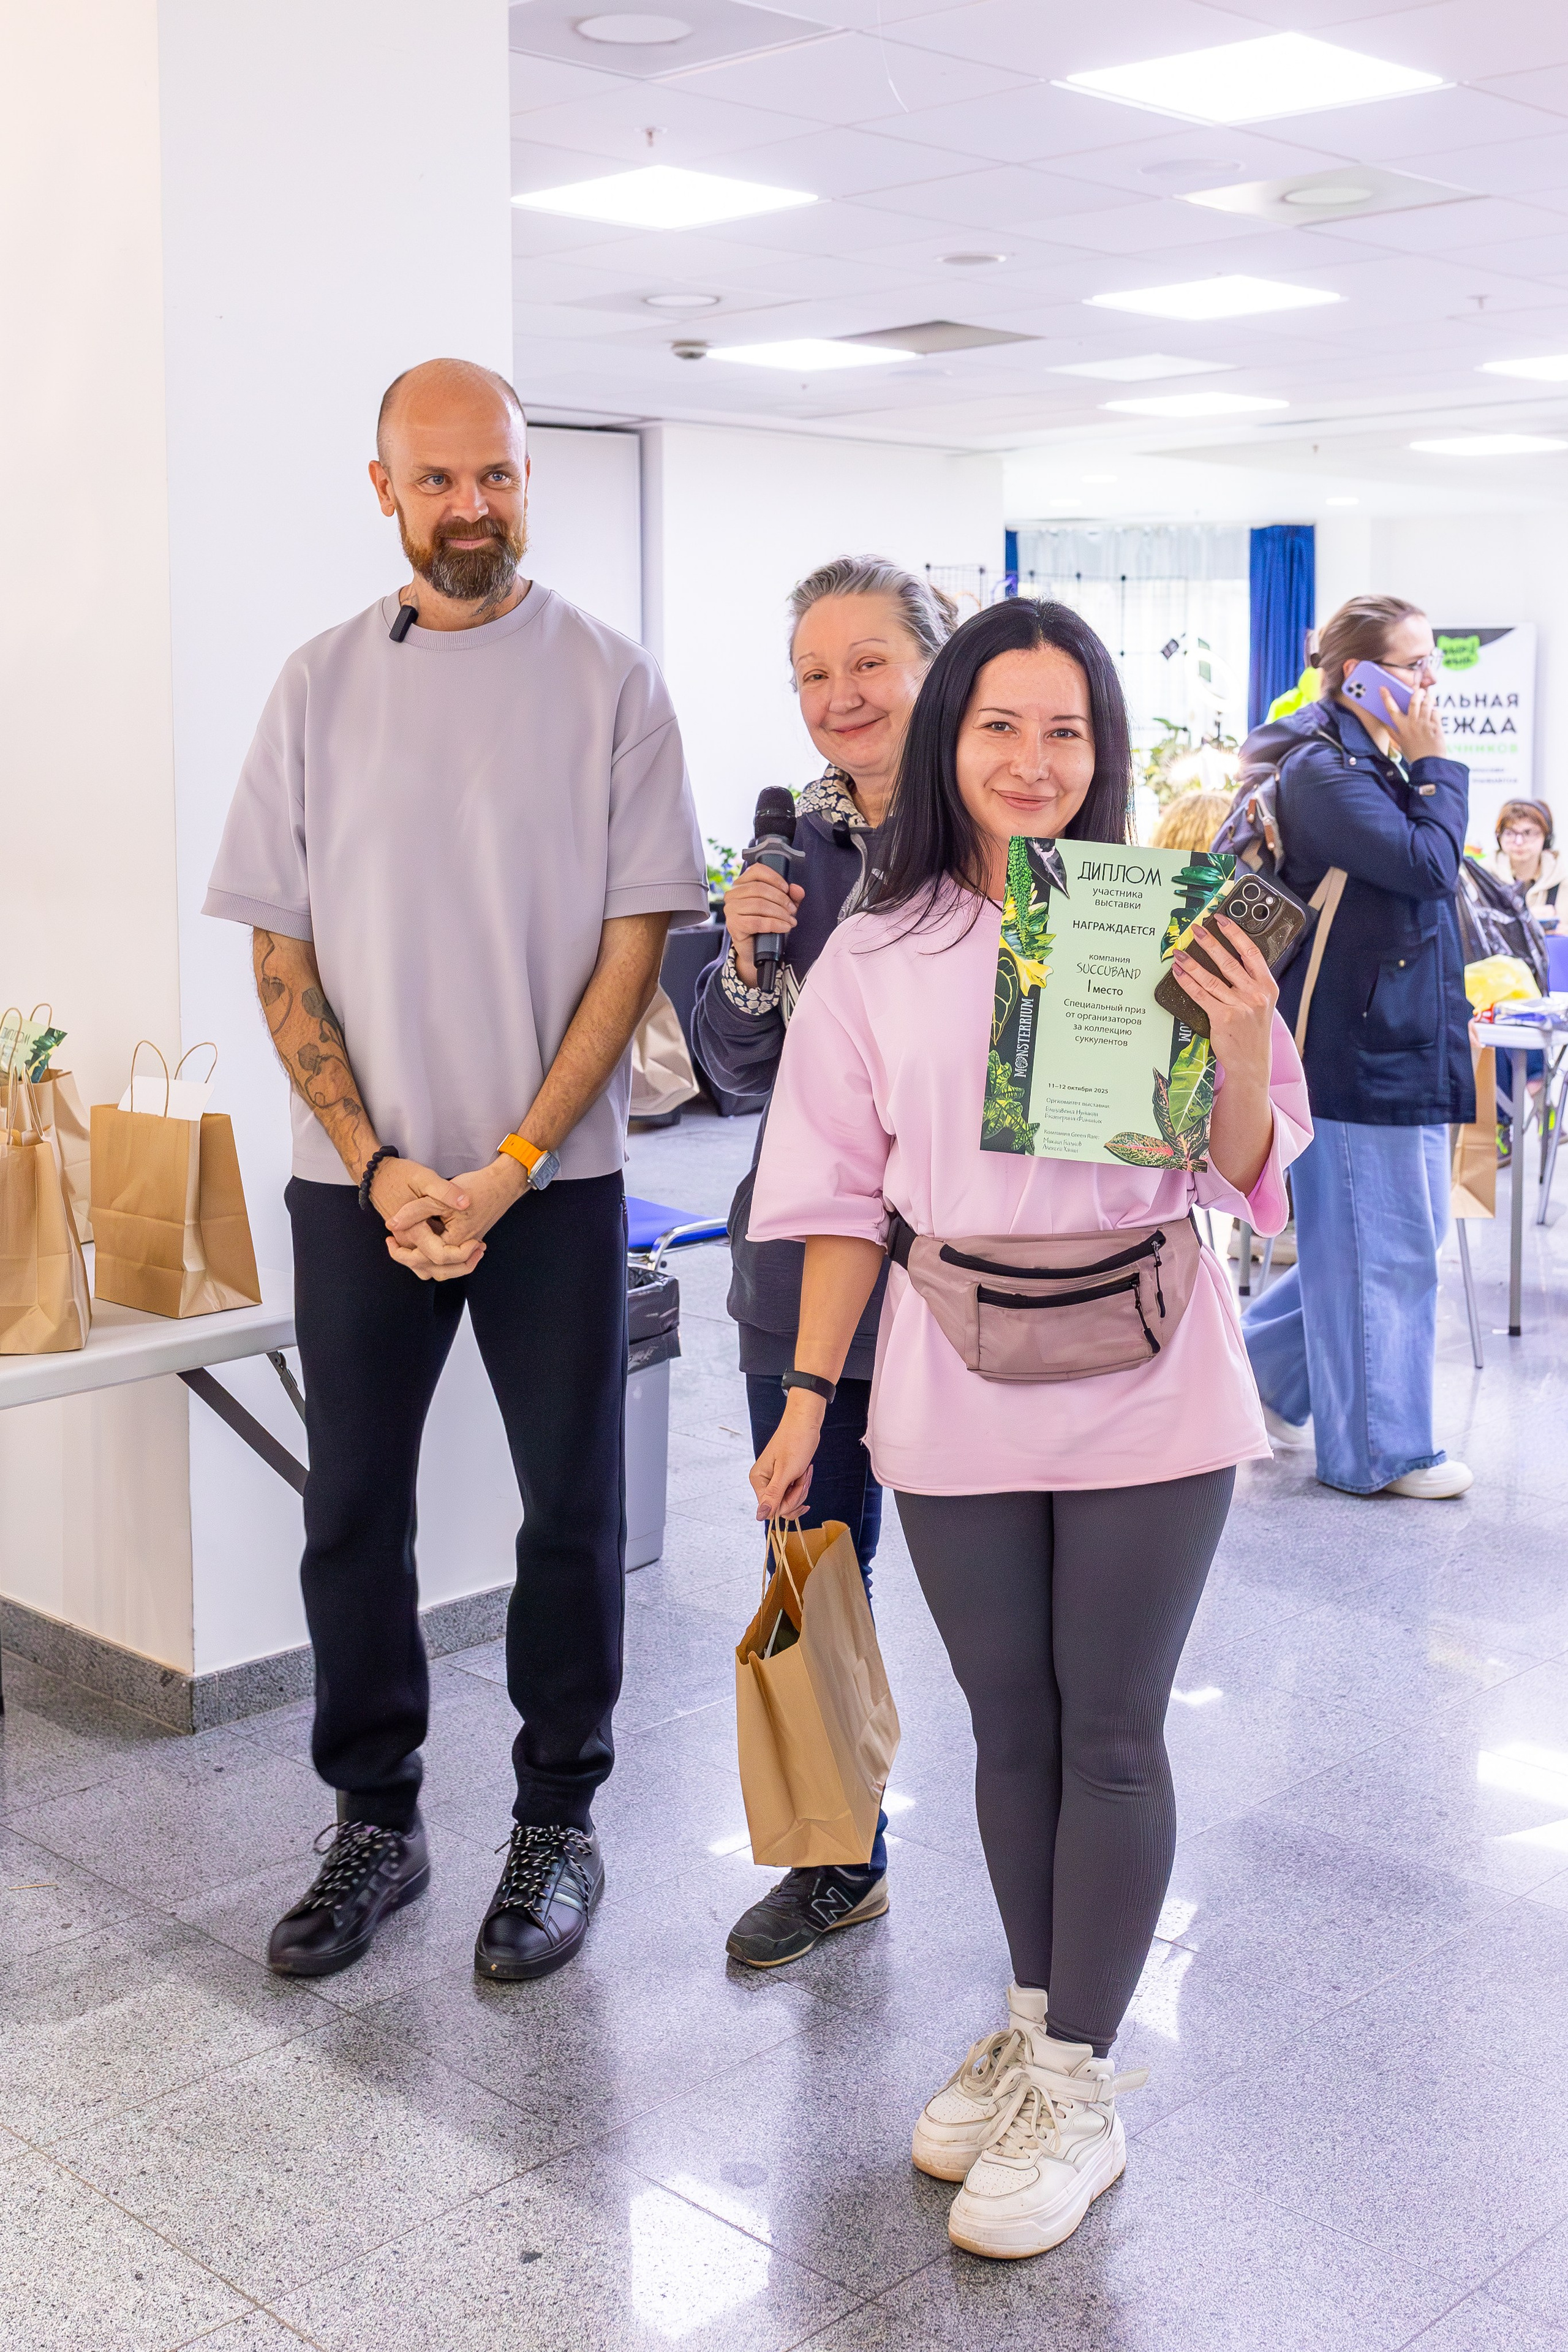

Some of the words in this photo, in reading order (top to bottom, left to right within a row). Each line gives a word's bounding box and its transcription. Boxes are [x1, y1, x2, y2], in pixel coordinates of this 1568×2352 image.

[1441, 717, 1517, 735] ЕЖДА
[1077, 861, 1162, 886] ДИПЛОМ
[1092, 888, 1143, 899] участника
[1095, 899, 1141, 910] выставки
[1072, 920, 1156, 936] НАГРАЖДАЕТСЯ
[1089, 954, 1131, 964] компания
[1076, 962, 1141, 980] SUCCUBAND
[1093, 986, 1123, 996] место
[1064, 998, 1123, 1012] Специальный
[1125, 1006, 1146, 1015] приз
[1077, 1012, 1142, 1025] организаторов
[1084, 1025, 1132, 1036] коллекцию
[1075, 1035, 1128, 1047] суккулентов
